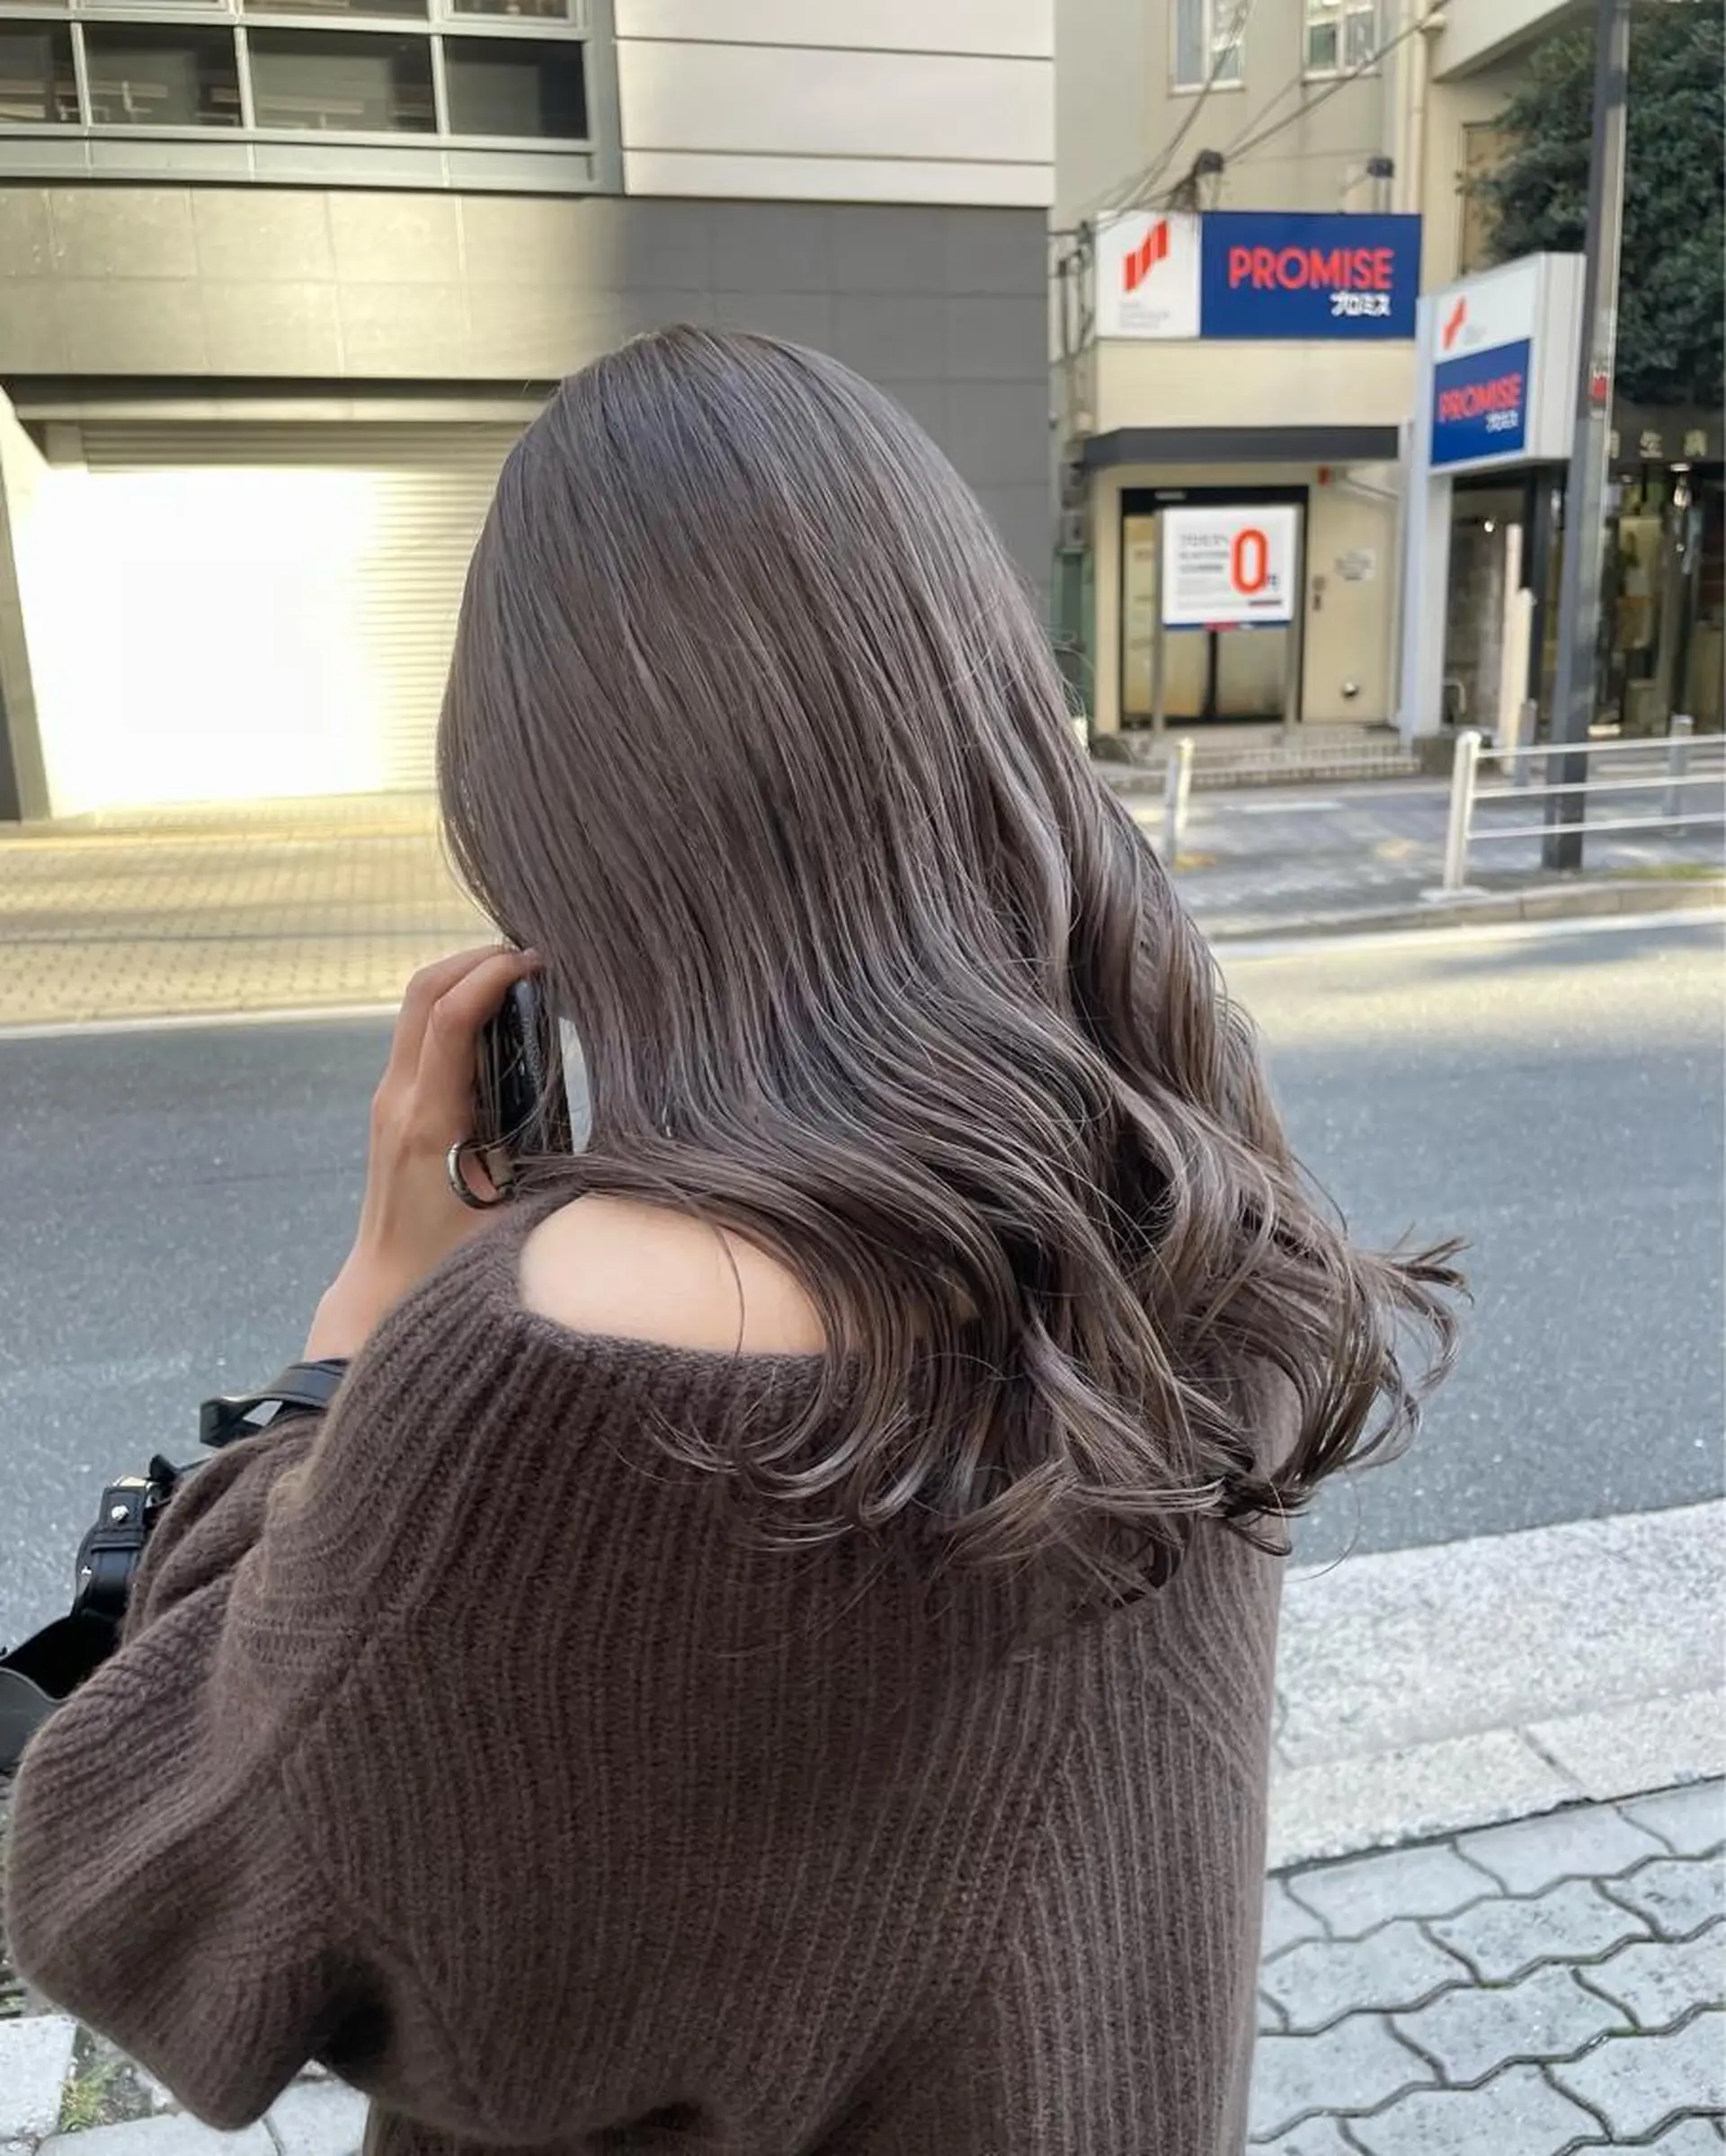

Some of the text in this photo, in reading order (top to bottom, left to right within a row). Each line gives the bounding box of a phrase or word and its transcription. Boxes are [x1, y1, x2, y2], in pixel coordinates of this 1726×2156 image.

[1229, 246, 1394, 289] PROMISE
[1439, 372, 1520, 422] PROMISE
[1232, 528, 1268, 594] 0
